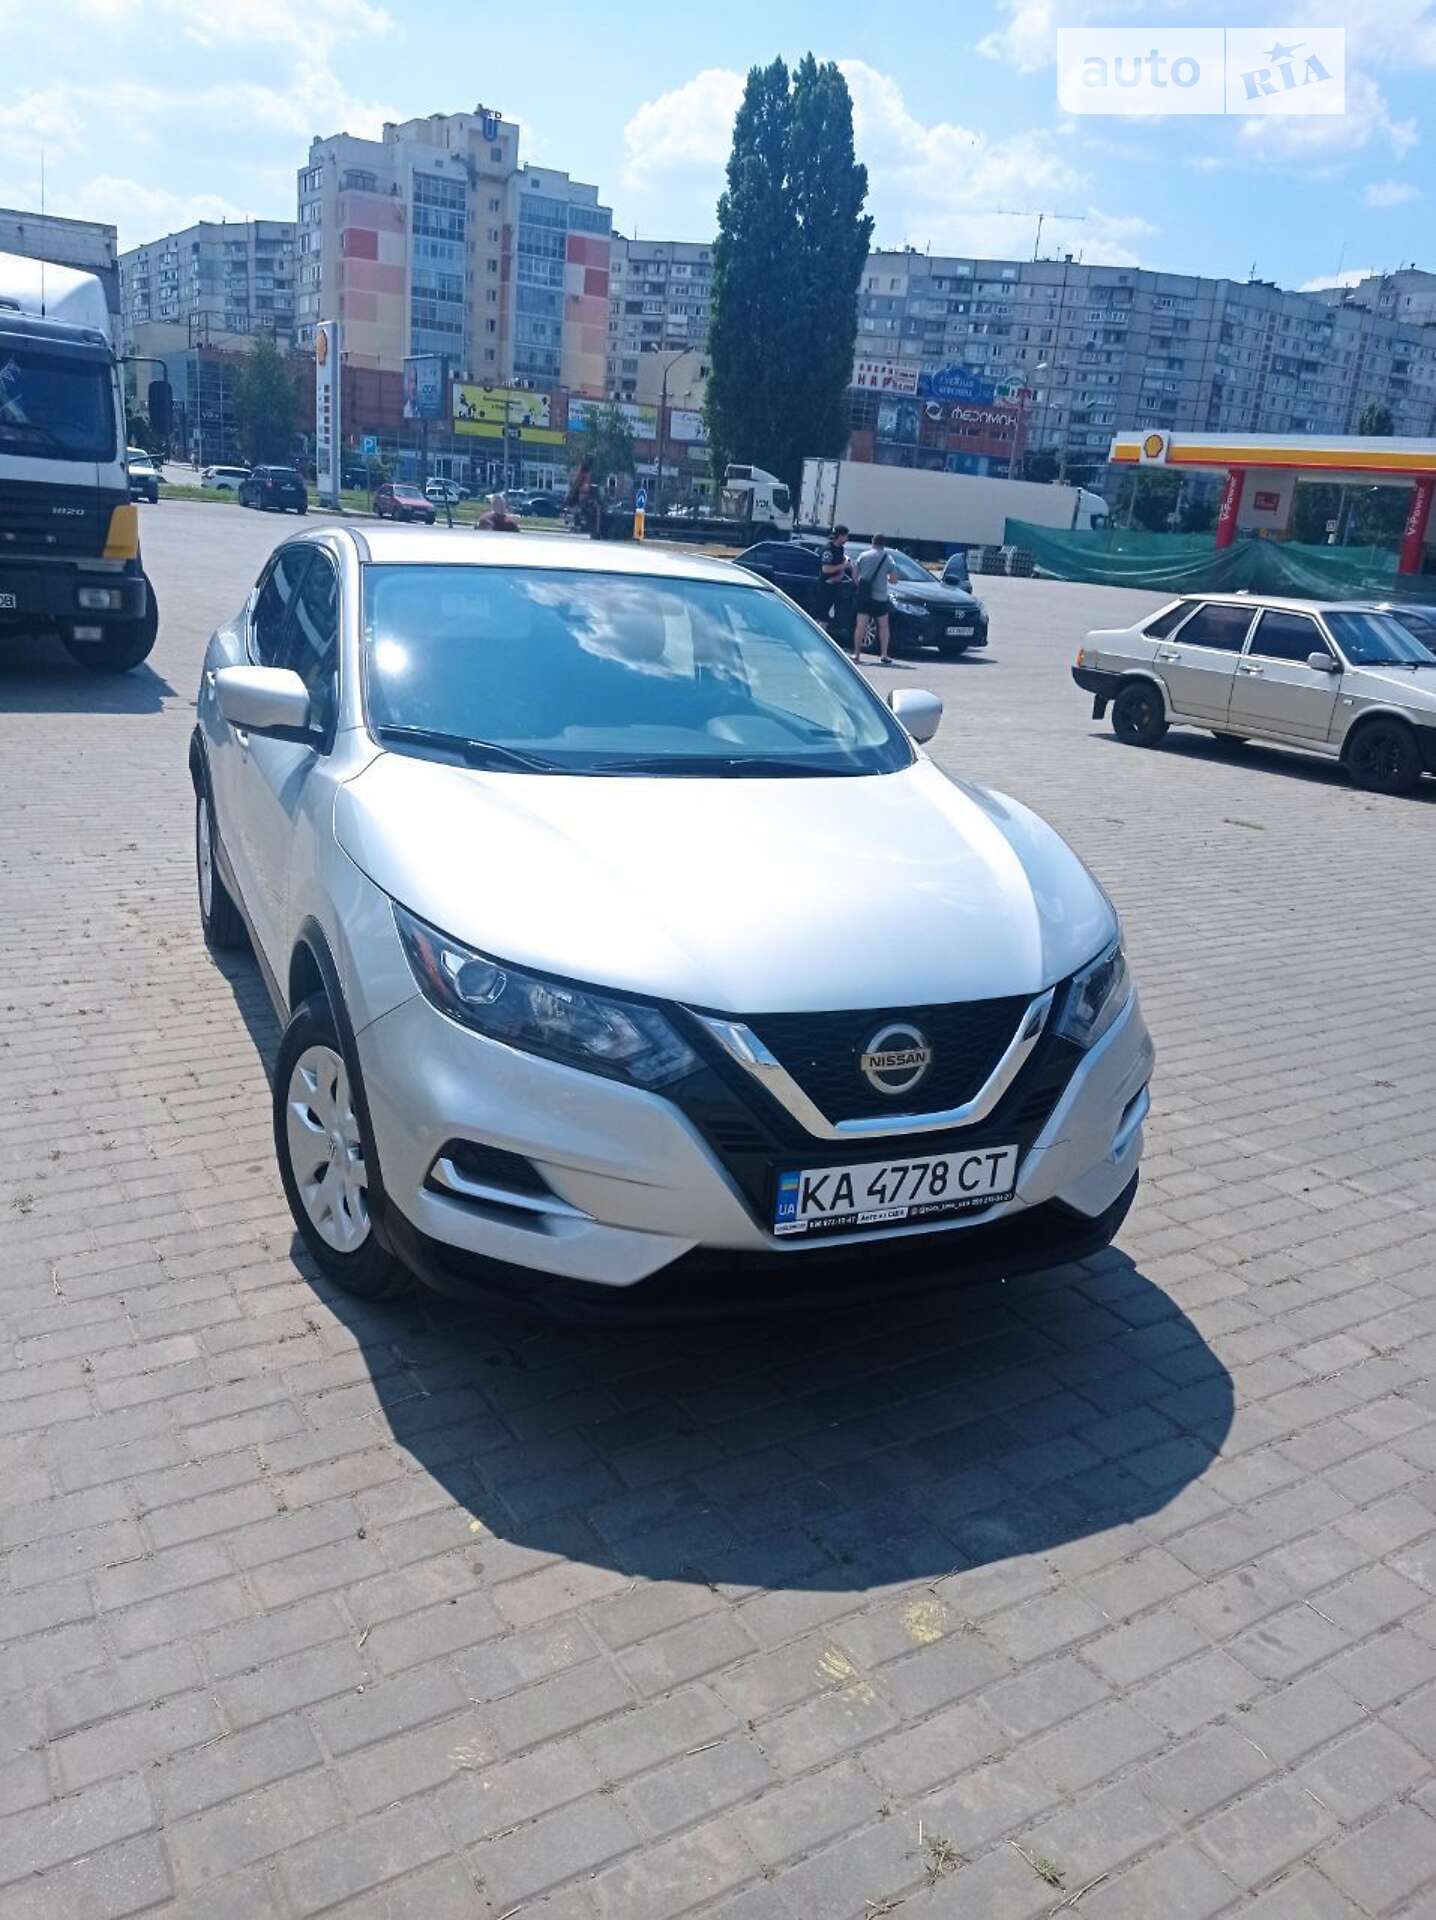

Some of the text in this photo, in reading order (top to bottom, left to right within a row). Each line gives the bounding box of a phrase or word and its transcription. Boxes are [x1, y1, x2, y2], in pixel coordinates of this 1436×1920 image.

[869, 1052, 926, 1067] NISSAN
[801, 1172, 855, 1214] KA
[866, 1160, 950, 1204] 4778
[958, 1151, 1009, 1192] CT
[779, 1202, 795, 1217] UA
